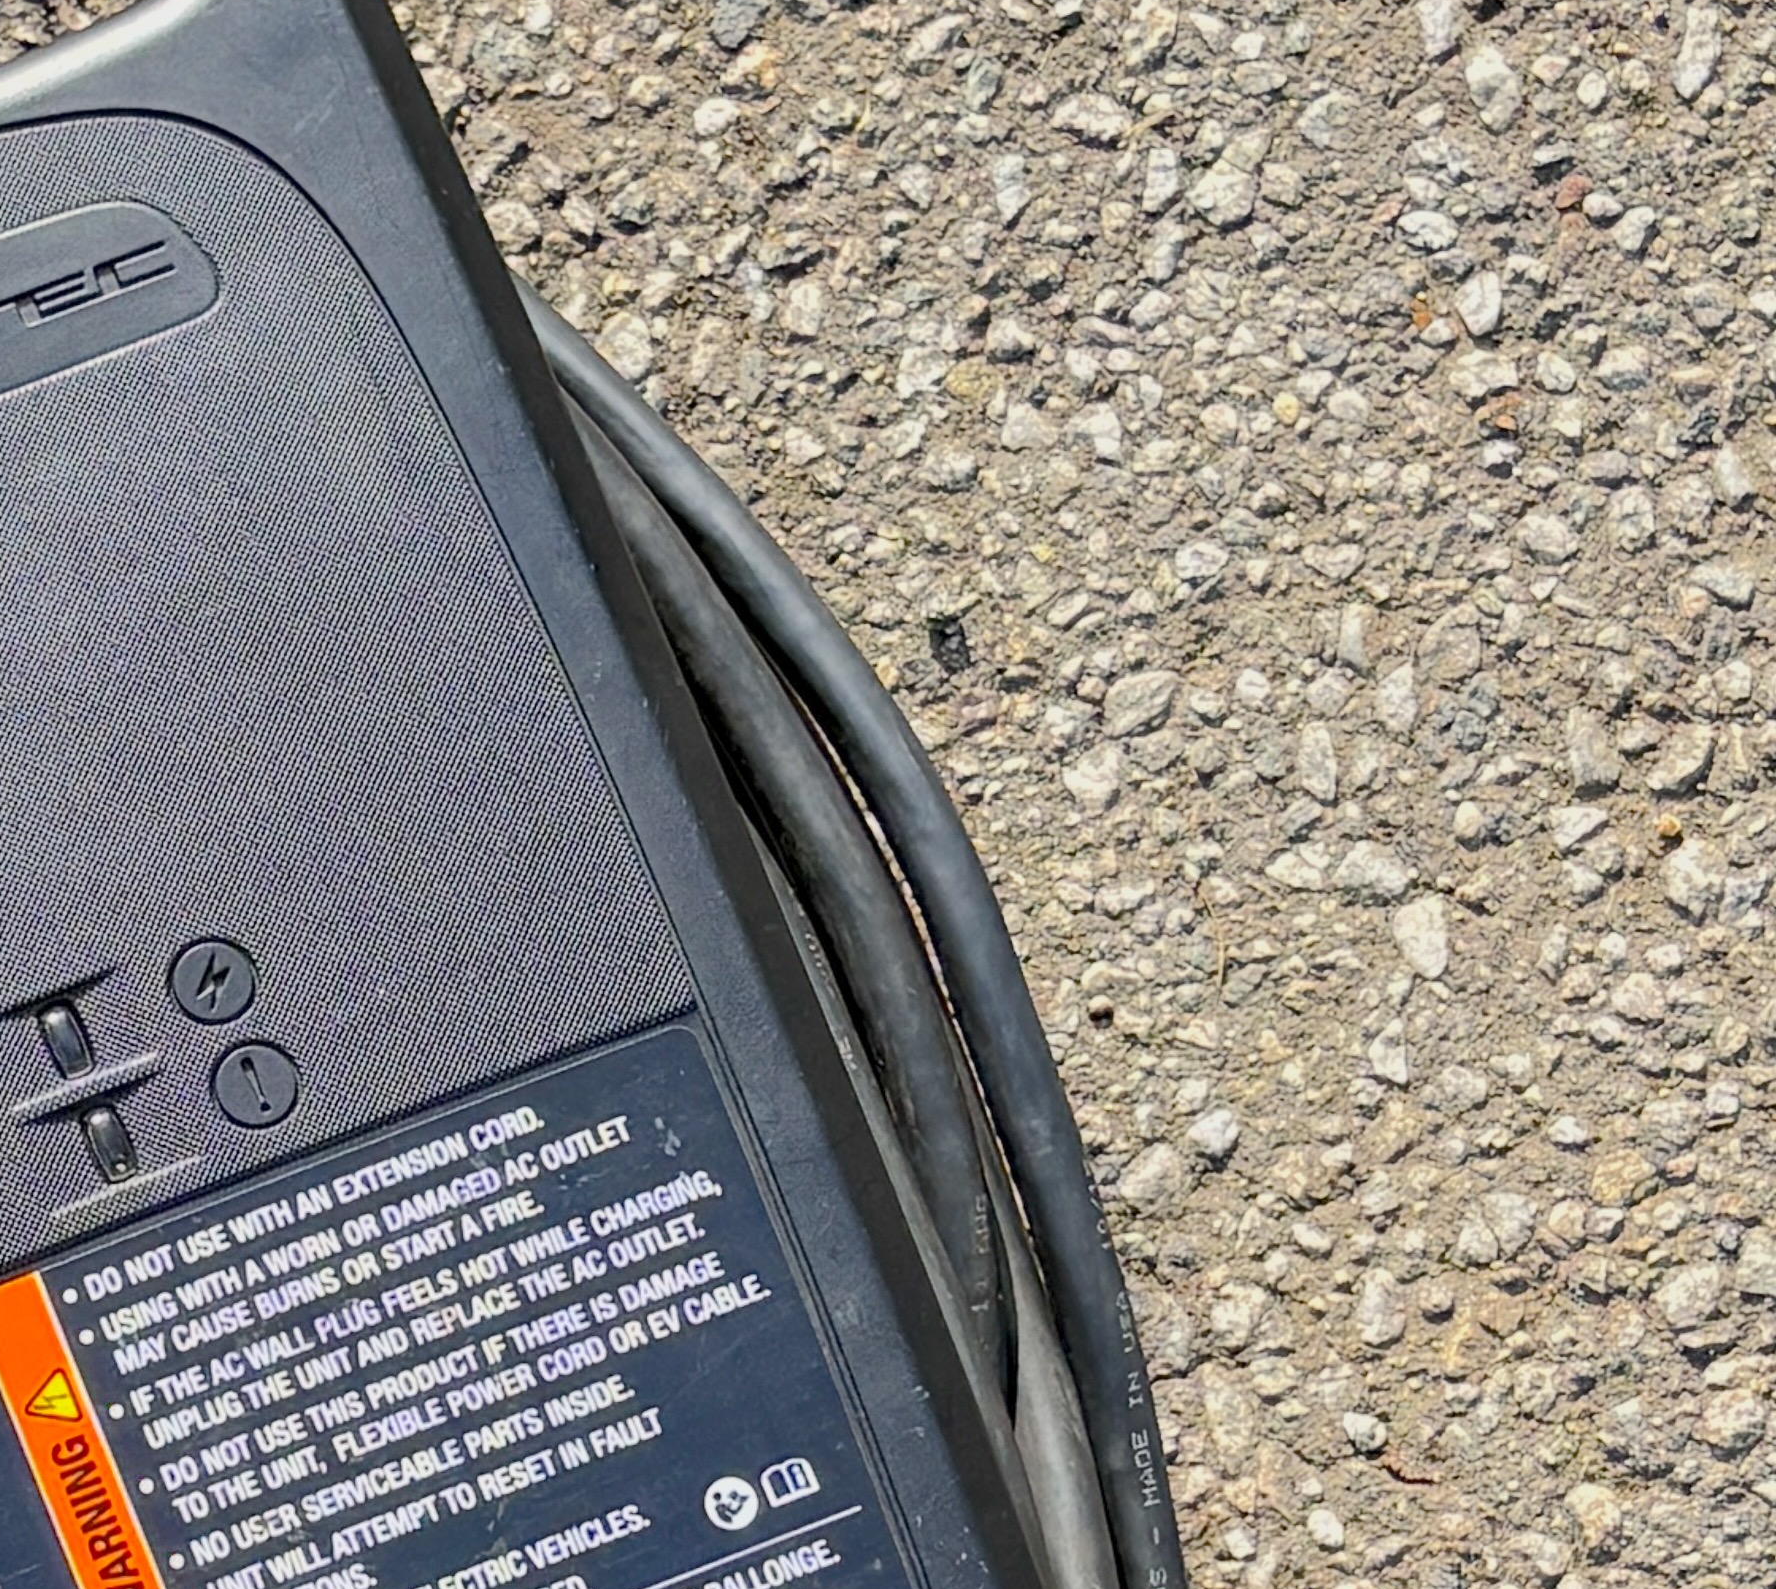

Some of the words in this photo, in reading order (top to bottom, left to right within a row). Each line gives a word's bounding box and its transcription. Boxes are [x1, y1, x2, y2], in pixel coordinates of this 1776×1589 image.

[83, 1266, 122, 1301] DO
[123, 1244, 174, 1285] NOT
[177, 1224, 231, 1264] USE
[227, 1199, 295, 1243] WITH
[296, 1185, 333, 1220] AN
[332, 1132, 468, 1204] EXTENSION
[469, 1106, 545, 1151] CORD.
[100, 1292, 179, 1341] USING
[176, 1266, 243, 1310] WITH
[245, 1259, 266, 1287] A
[262, 1228, 342, 1276] WORN
[342, 1214, 382, 1247] OR
[381, 1167, 502, 1232] DAMAGED
[504, 1152, 539, 1186] AC
[540, 1116, 630, 1170] OUTLET
[114, 1333, 166, 1374] MAY
[171, 1300, 255, 1351] CAUSE
[254, 1267, 341, 1319] BURNS
[342, 1252, 381, 1285] OR
[381, 1220, 456, 1270] START
[461, 1214, 482, 1241] A
[480, 1190, 544, 1232] FIRE.
[130, 1385, 154, 1416] IF
[155, 1365, 209, 1404] THE
[210, 1352, 245, 1386] AC
[242, 1327, 315, 1370] WALL
[314, 1299, 382, 1343] PLUG
[381, 1268, 459, 1318] FEELS
[458, 1247, 508, 1287] HOT
[509, 1217, 590, 1267] WHILE
[590, 1171, 722, 1236] CHARGING,
[143, 1391, 245, 1449] UNPLUG
[241, 1370, 296, 1409] THE
[294, 1347, 352, 1389] UNIT
[358, 1327, 409, 1367] AND
[410, 1283, 521, 1345] REPLACE
[517, 1263, 572, 1302] THE
[573, 1250, 607, 1284] AC
[608, 1213, 705, 1268] OUTLET.
[159, 1456, 199, 1491] DO
[200, 1433, 251, 1475] NOT
[254, 1413, 308, 1453] USE
[304, 1391, 365, 1432] THIS
[365, 1344, 478, 1410] PRODUCT
[481, 1334, 506, 1365] IF
[506, 1303, 590, 1353] THERE
[589, 1293, 618, 1323] IS
[618, 1252, 725, 1311] DAMAGE
[172, 1491, 209, 1523] TO
[207, 1470, 262, 1509] THE
[261, 1445, 327, 1489] UNIT,
[332, 1398, 447, 1462] FLEXIBLE
[446, 1363, 537, 1417] POWER
[537, 1336, 607, 1381] CORD
[609, 1320, 648, 1353] OR
[647, 1305, 680, 1339] EV
[683, 1275, 771, 1324] CABLE.
[1126, 1371, 1145, 1407] IN
[190, 1530, 230, 1566] NO
[231, 1503, 302, 1549] USER
[301, 1439, 464, 1522] SERVICEABLE
[463, 1408, 544, 1459] PARTS
[544, 1375, 635, 1427] INSIDE.
[265, 1542, 331, 1583] WILL
[332, 1494, 439, 1560] ATTEMPT
[439, 1482, 477, 1514] TO
[477, 1449, 556, 1501] RESET
[558, 1438, 590, 1469] IN
[589, 1407, 662, 1457] FAULT
[525, 1505, 651, 1569] VEHICLES.
[1130, 1430, 1161, 1506] MADE
